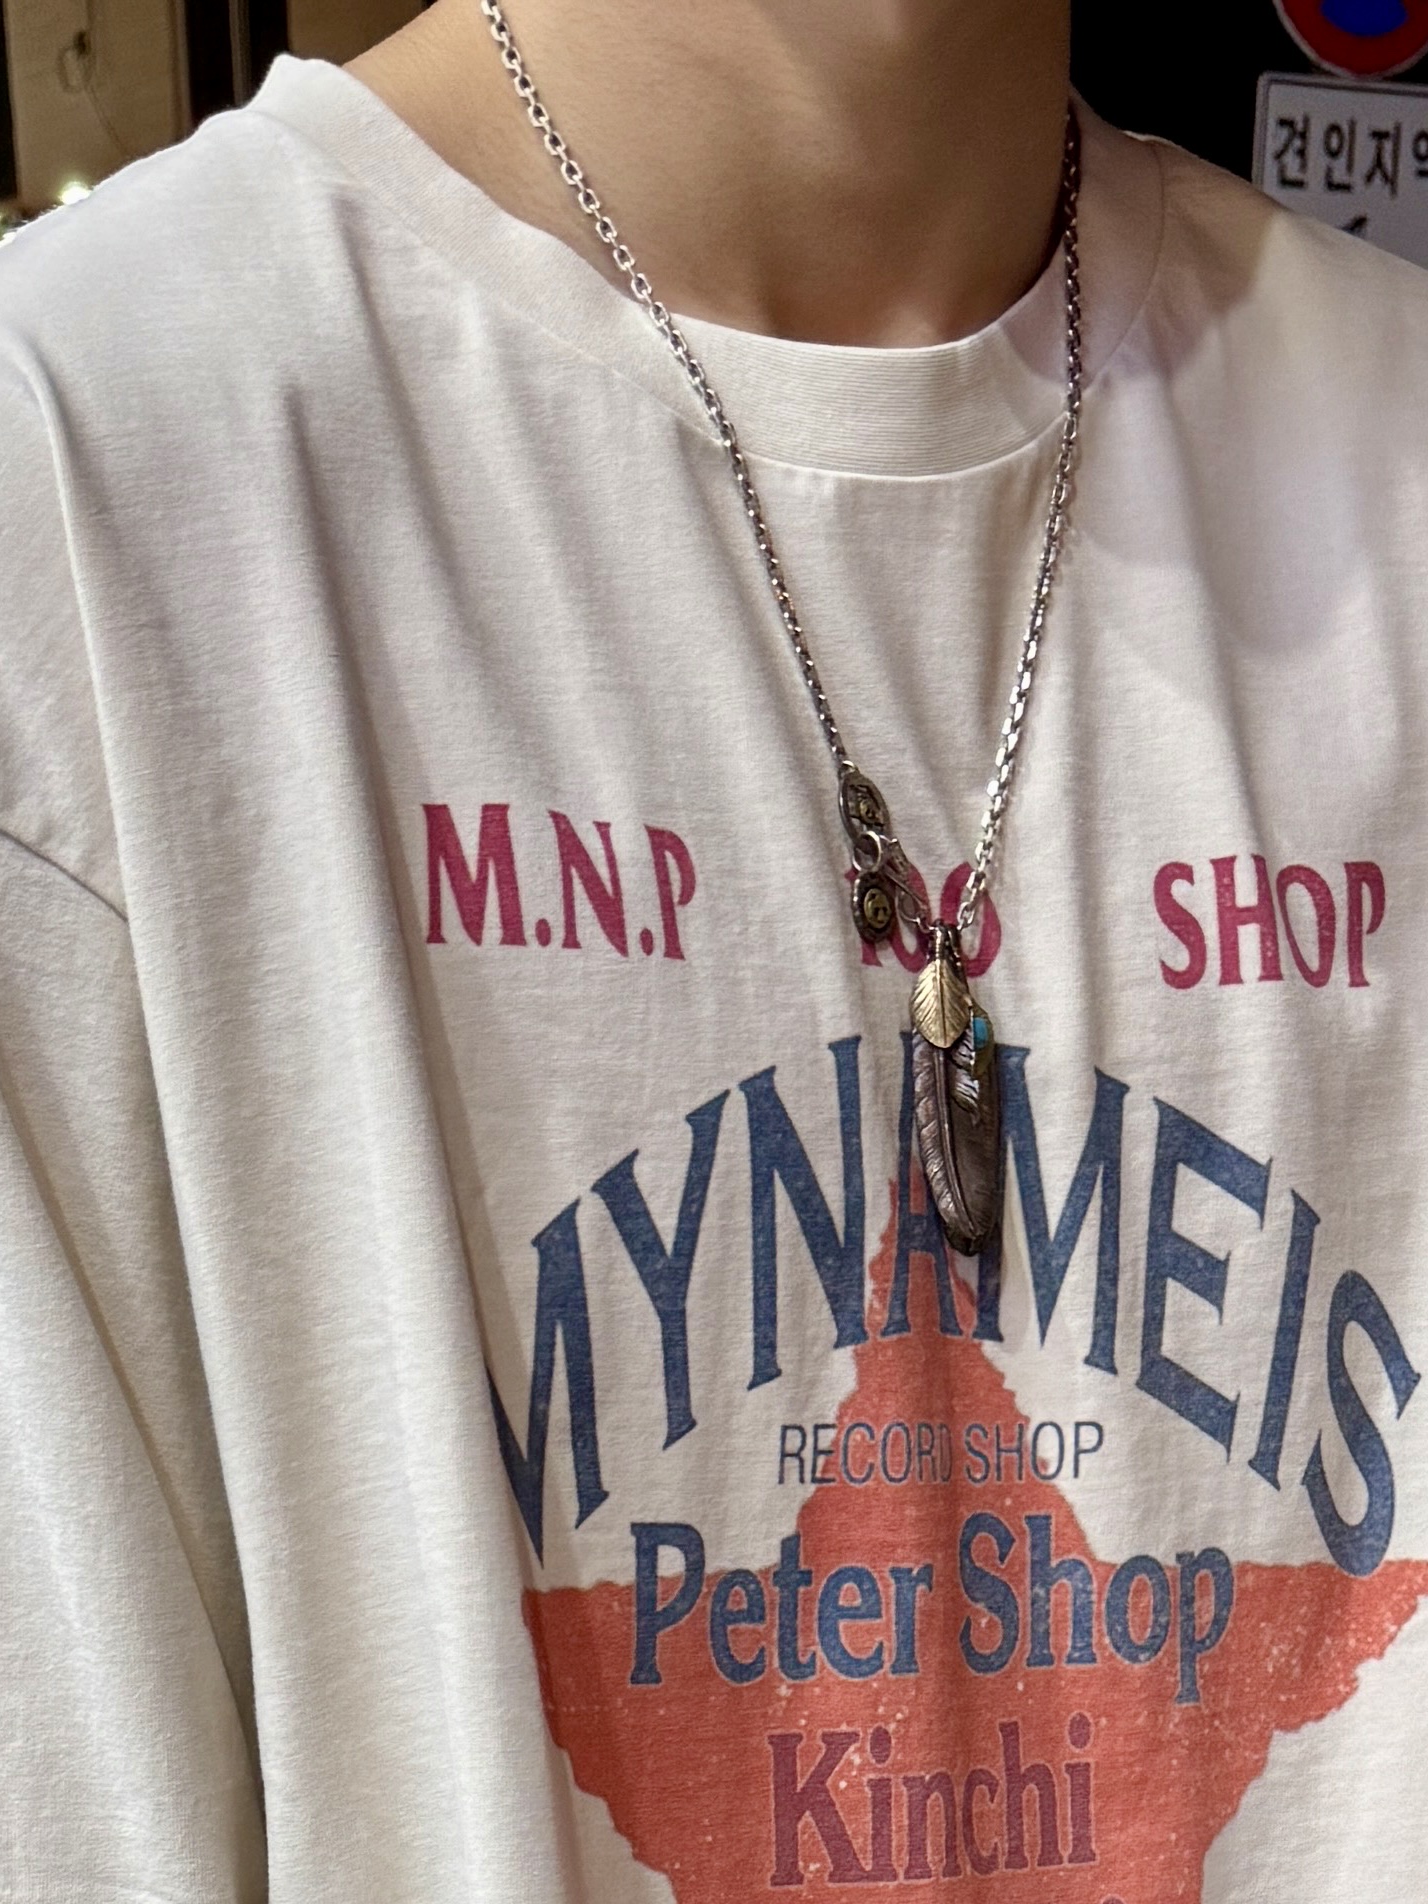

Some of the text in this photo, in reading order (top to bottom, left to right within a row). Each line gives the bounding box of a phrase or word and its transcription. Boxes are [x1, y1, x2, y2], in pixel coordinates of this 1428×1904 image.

[421, 803, 696, 961] M.N.P
[1153, 853, 1386, 989] SHOP
[777, 1420, 1105, 1486] RECORD SHOP
[629, 1512, 1235, 1704] Peter Shop
[767, 1712, 1099, 1887] Kinchi
